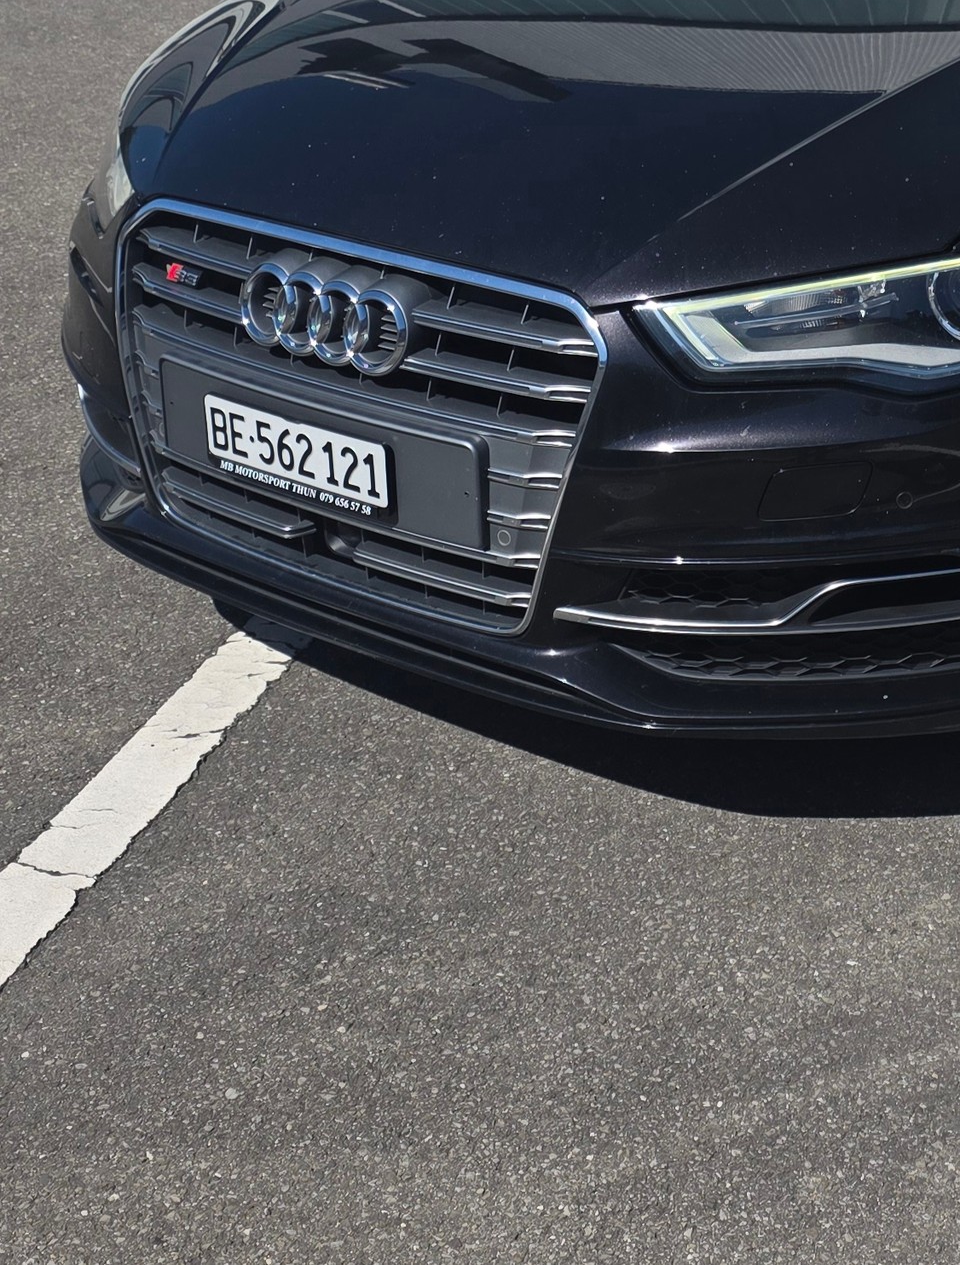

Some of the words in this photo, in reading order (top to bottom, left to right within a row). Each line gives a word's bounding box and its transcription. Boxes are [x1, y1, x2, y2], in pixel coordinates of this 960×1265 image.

[220, 460, 234, 472] MB
[235, 464, 291, 490] MOTORSPORT
[292, 483, 317, 499] THUN
[319, 492, 334, 504] 079
[335, 497, 349, 509] 656
[350, 501, 360, 512] 57
[361, 505, 372, 515] 58
